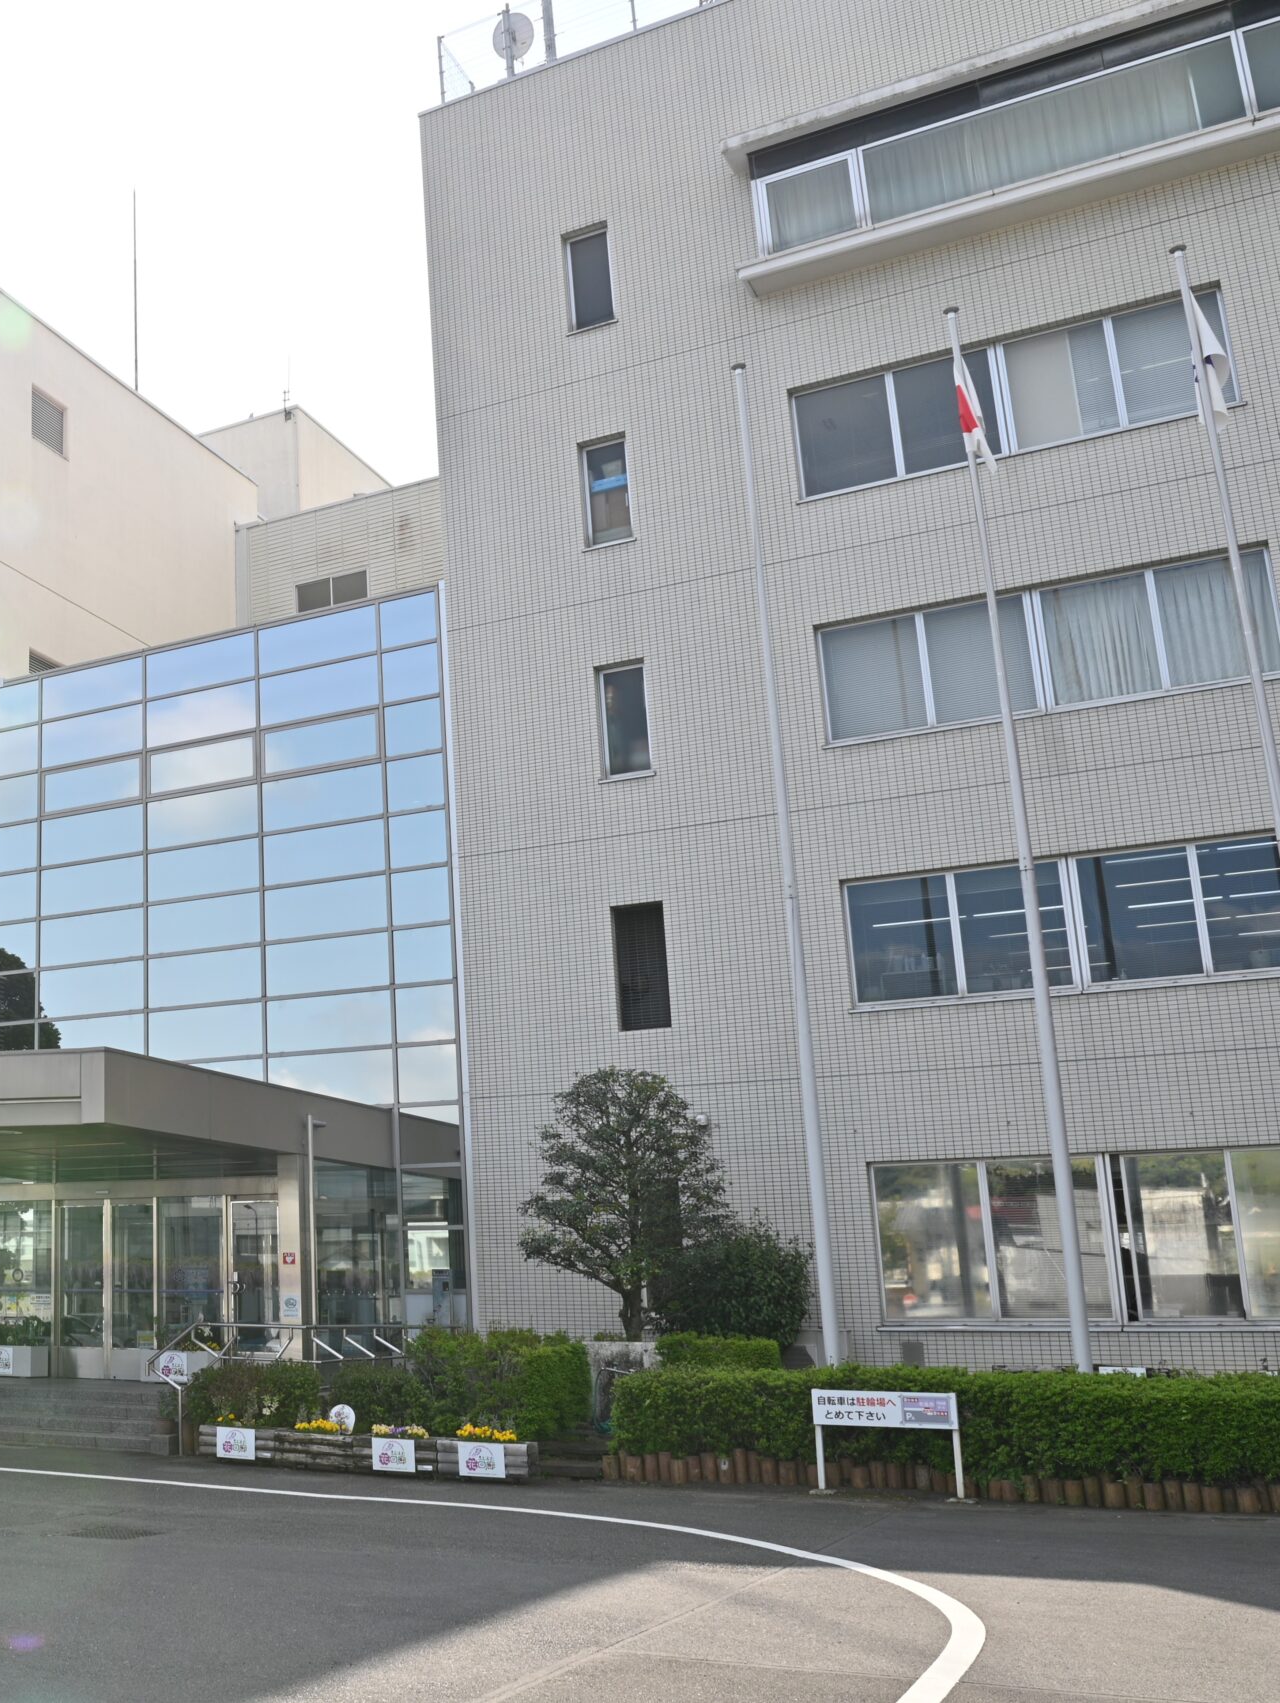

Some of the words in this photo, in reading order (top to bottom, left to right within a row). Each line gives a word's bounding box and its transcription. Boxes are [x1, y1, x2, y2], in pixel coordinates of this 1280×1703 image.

[817, 1396, 897, 1408] 自転車は駐輪場へ
[824, 1409, 886, 1422] とめて下さい
